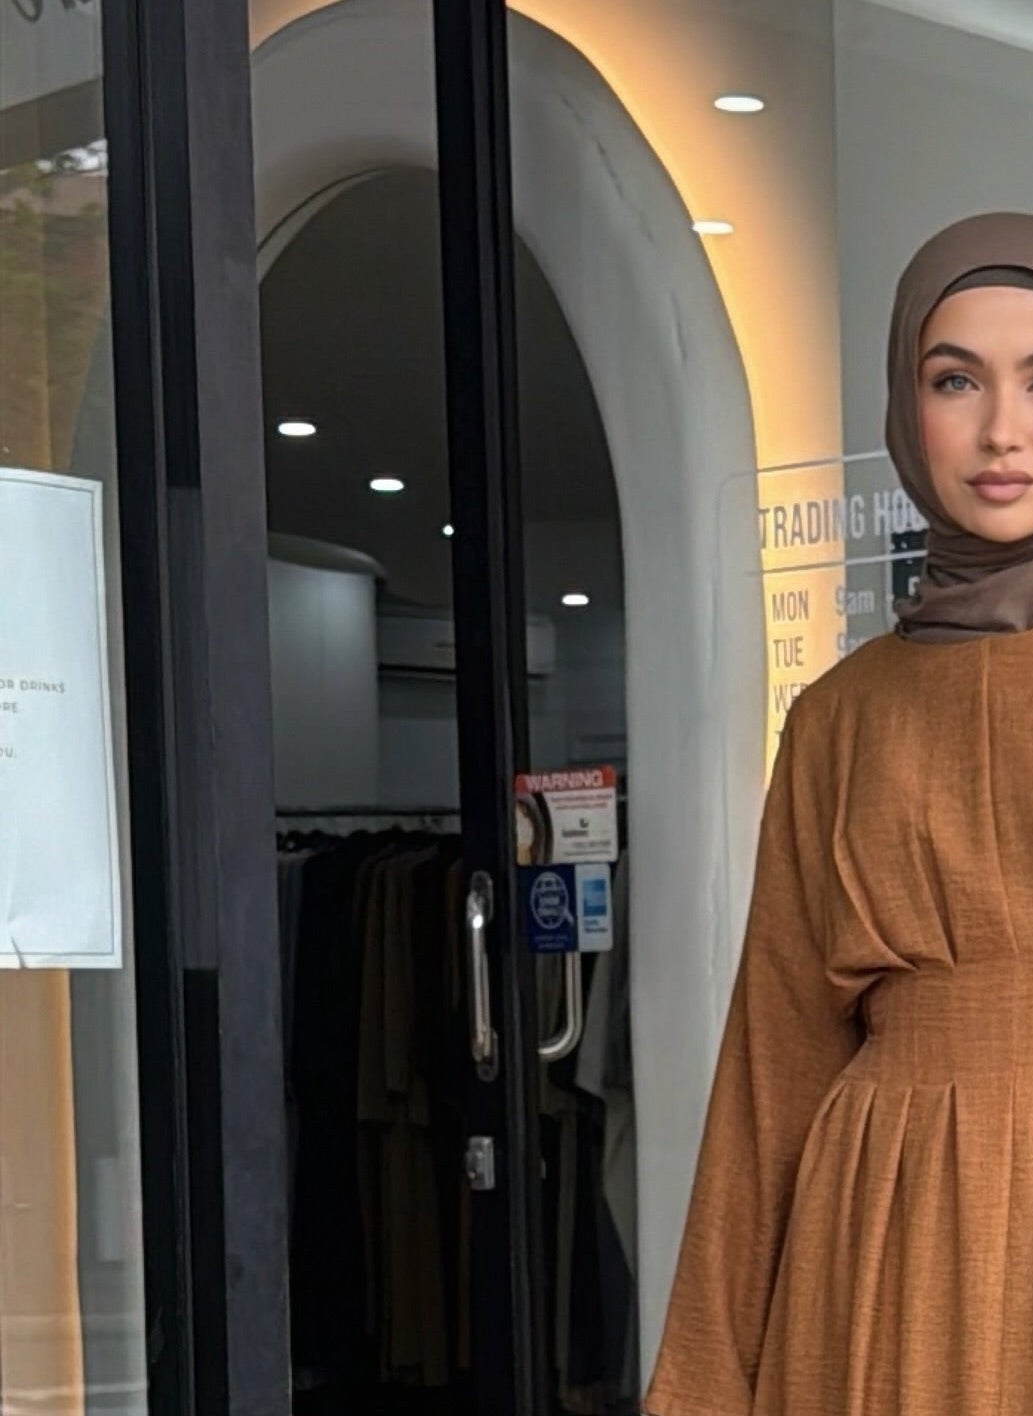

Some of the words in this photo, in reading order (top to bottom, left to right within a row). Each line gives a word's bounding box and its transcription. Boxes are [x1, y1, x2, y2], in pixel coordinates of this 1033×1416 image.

[757, 494, 866, 550] TRADING
[873, 488, 926, 536] HOU
[772, 590, 809, 622] MON
[773, 637, 804, 668] TUE
[20, 680, 65, 694] DRINKS
[527, 770, 604, 792] WARNING
